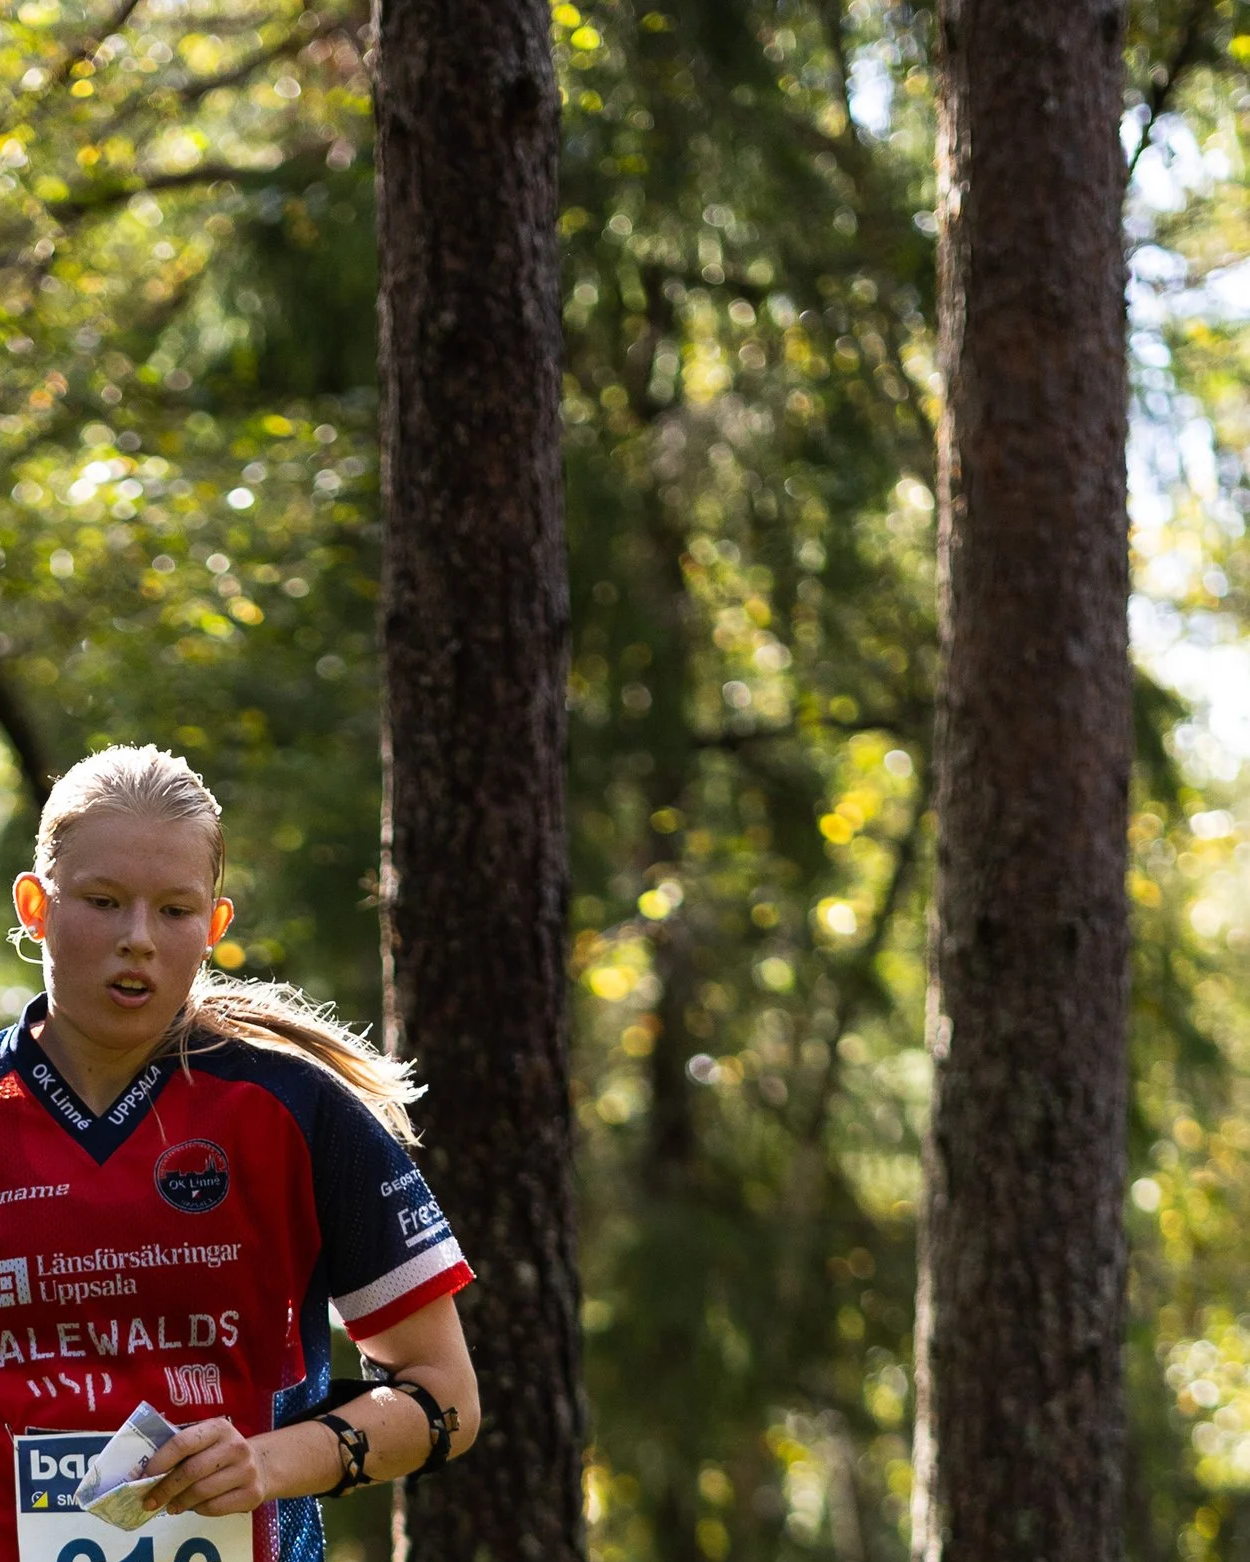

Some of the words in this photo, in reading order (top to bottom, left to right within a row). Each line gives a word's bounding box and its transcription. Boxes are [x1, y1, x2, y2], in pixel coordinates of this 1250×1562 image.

[32, 1064, 56, 1091] OK
[50, 1088, 92, 1130] Linné
[108, 1065, 162, 1125] UPPSALA
[169, 1180, 186, 1190] OK
[36, 1242, 242, 1278] Länsförsäkringar
[39, 1274, 138, 1306] Uppsala
